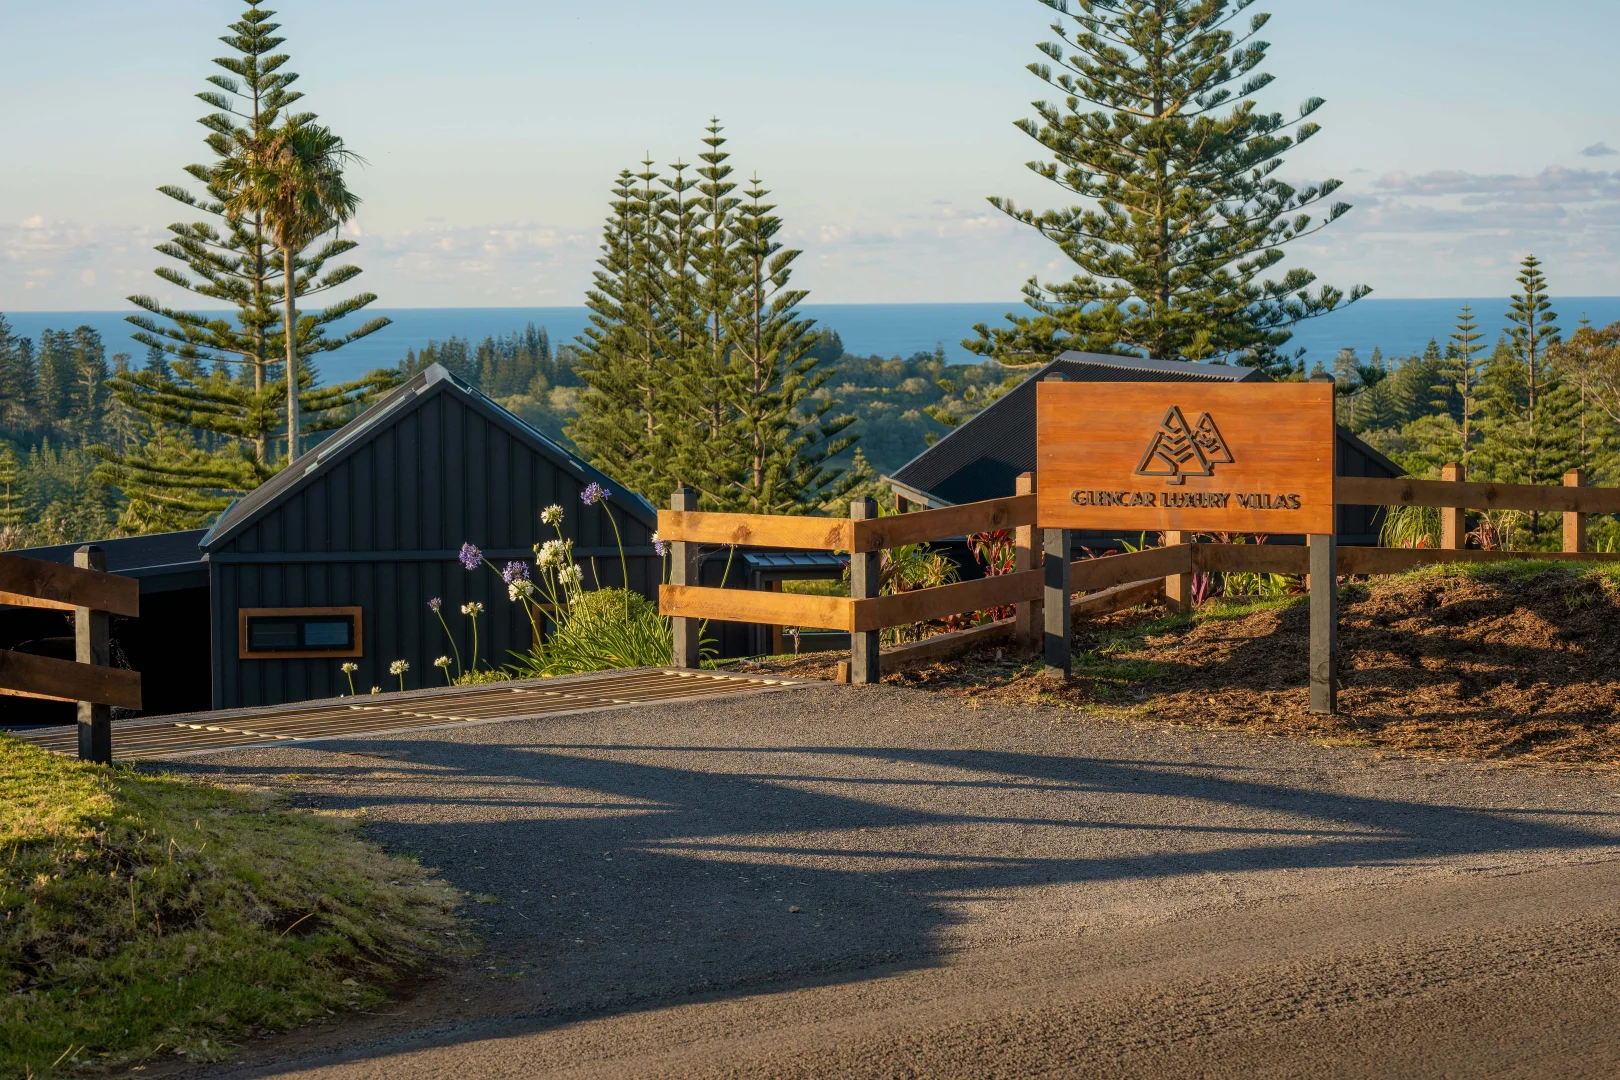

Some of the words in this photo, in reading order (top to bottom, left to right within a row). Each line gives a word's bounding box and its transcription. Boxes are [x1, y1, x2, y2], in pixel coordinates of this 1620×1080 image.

[1071, 490, 1156, 507] GLENCAR
[1160, 492, 1230, 508] LUXURY
[1235, 493, 1301, 510] VILLAS
